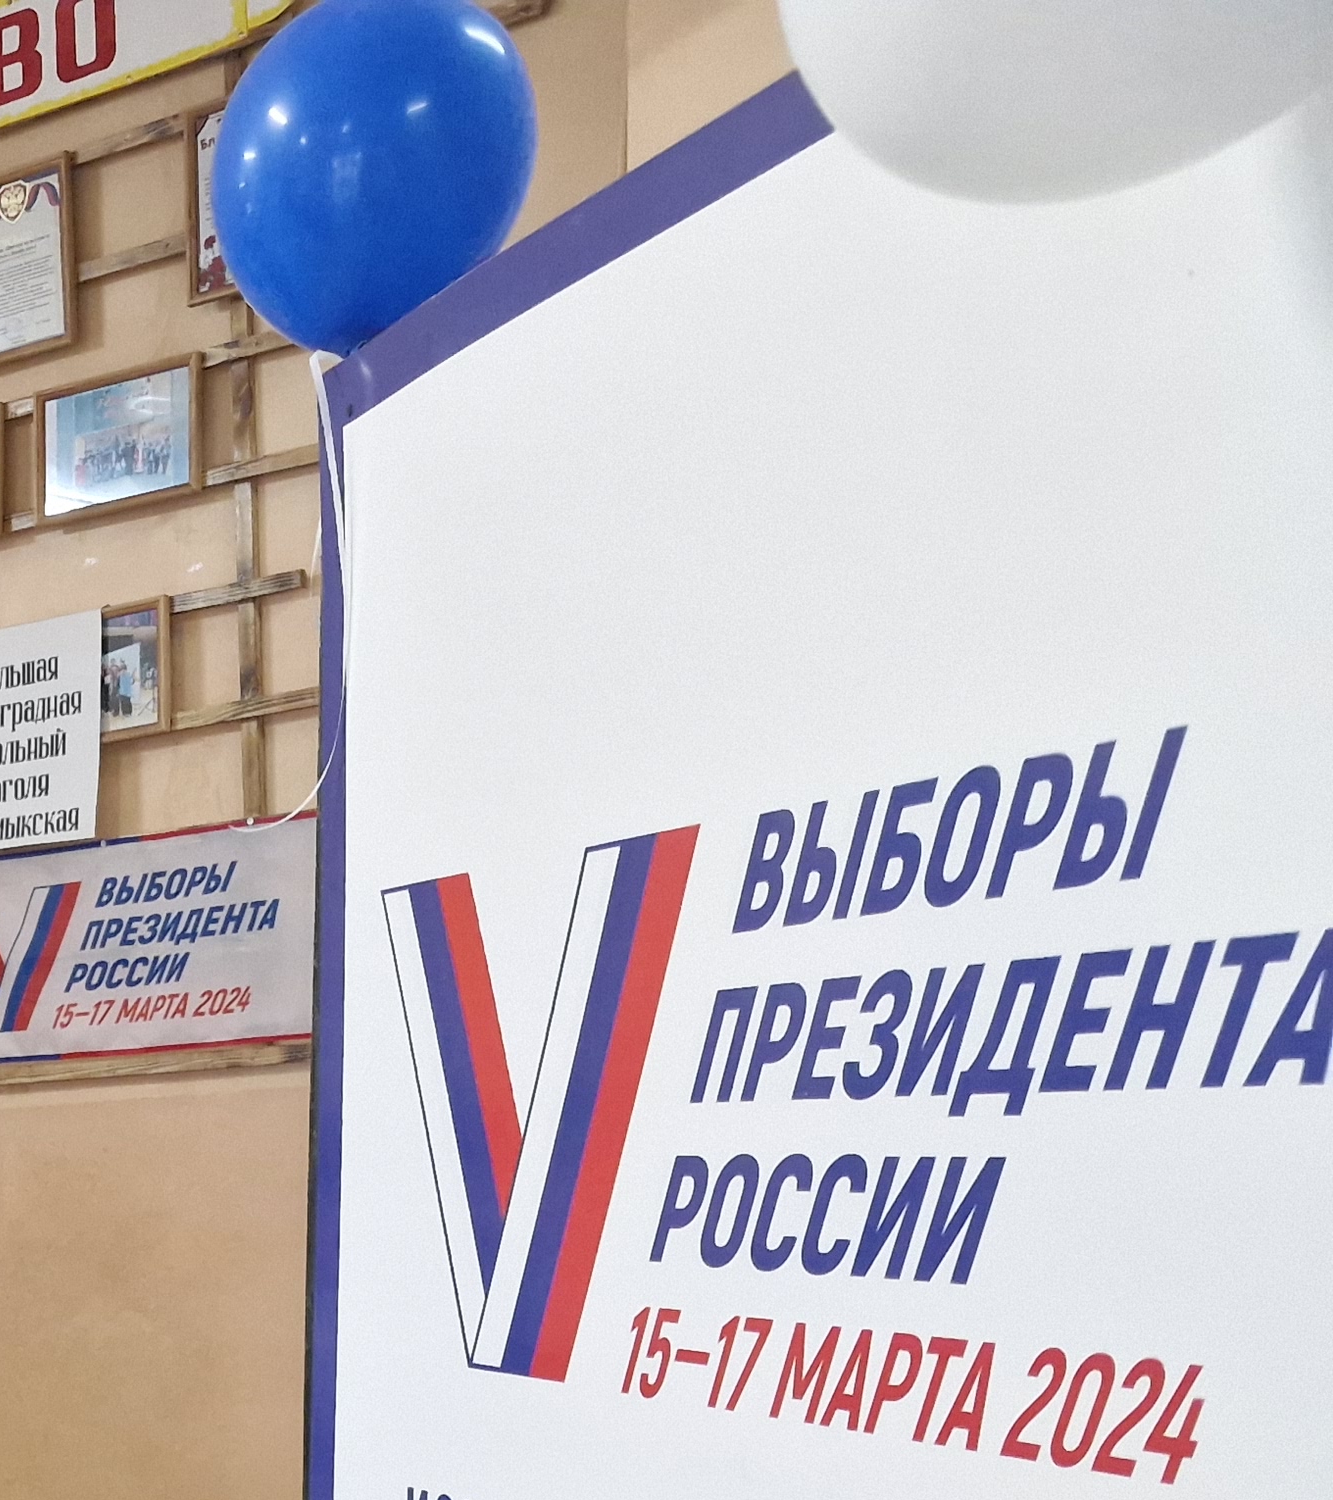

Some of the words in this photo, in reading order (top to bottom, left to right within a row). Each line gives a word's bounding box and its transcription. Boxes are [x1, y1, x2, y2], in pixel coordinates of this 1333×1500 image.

[732, 724, 1189, 935] ВЫБОРЫ
[80, 898, 280, 951] ПРЕЗИДЕНТА
[94, 860, 238, 908] ВЫБОРЫ
[64, 951, 190, 993] РОССИИ
[114, 992, 190, 1024] МАРТА
[192, 986, 252, 1018] 2024
[690, 927, 1333, 1117] ПРЕЗИДЕНТА
[649, 1152, 1007, 1286] РОССИИ
[768, 1321, 997, 1452] МАРТА
[1000, 1346, 1207, 1484] 2024
